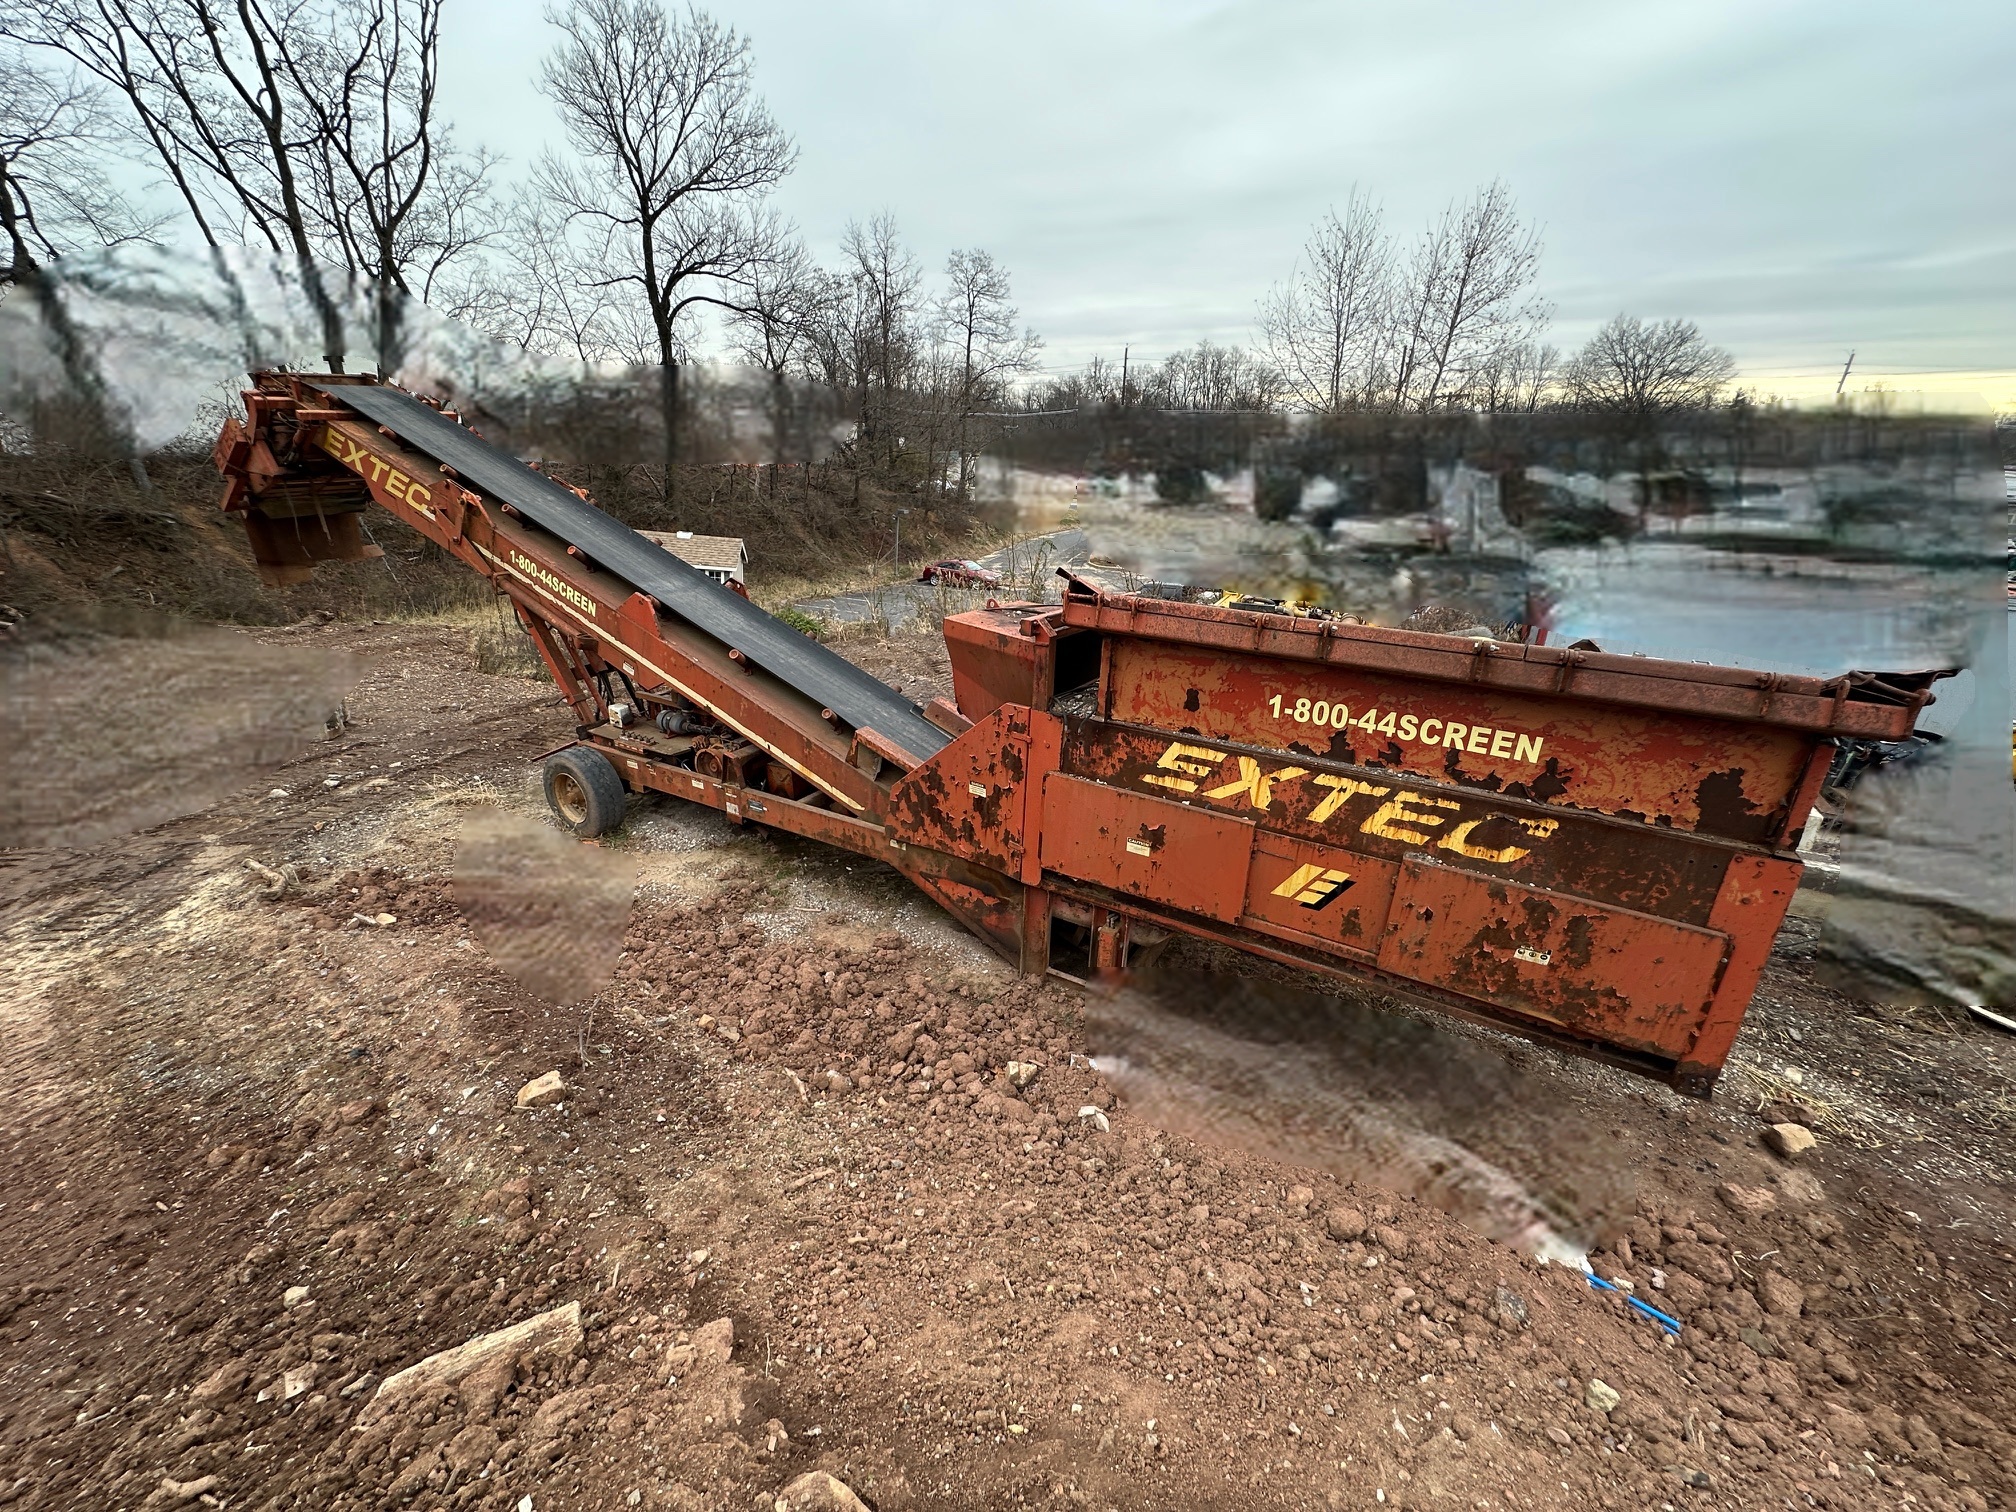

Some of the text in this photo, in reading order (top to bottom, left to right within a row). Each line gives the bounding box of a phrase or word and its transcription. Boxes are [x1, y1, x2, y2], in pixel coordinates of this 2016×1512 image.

[325, 427, 433, 514] EXTEC
[510, 549, 597, 617] 1-800-44SCREEN
[1268, 694, 1544, 764] 1-800-44SCREEN
[1141, 741, 1560, 863] EXTEC
